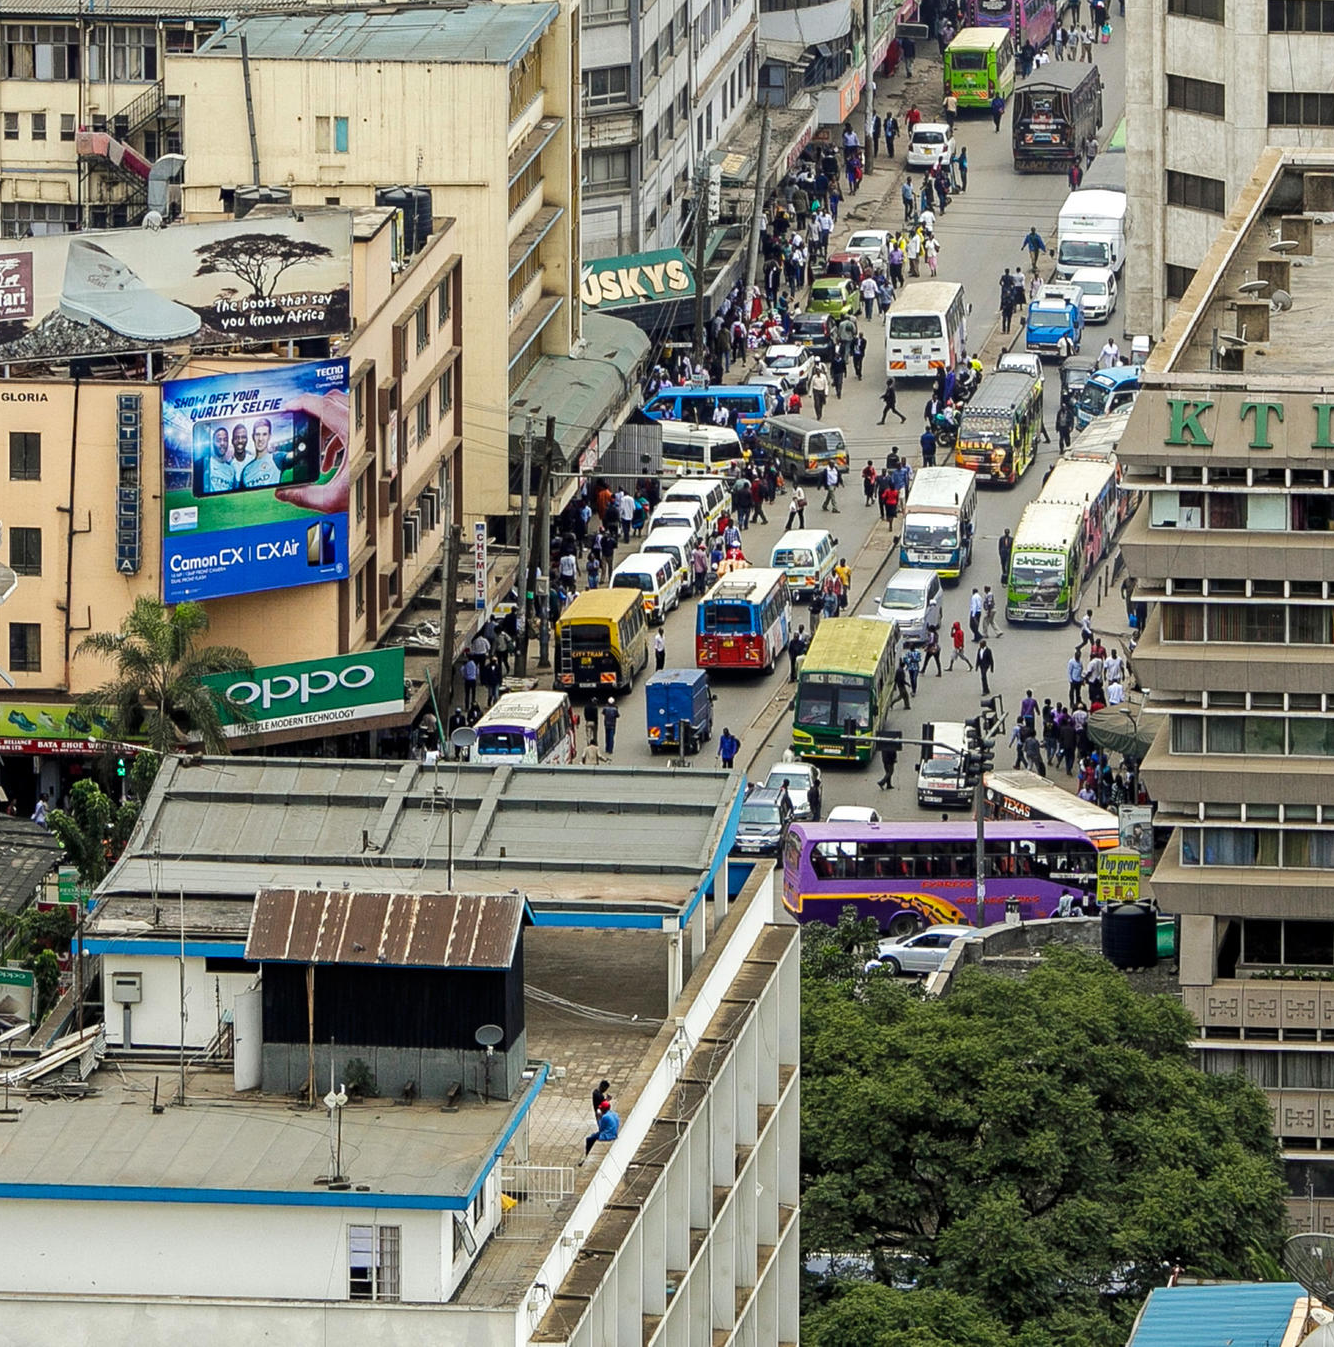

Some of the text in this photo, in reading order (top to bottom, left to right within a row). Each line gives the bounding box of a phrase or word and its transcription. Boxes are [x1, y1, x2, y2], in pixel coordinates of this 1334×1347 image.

[215, 293, 333, 313] The boots that say
[221, 308, 326, 330] you know Africa
[315, 365, 344, 378] TECNO
[0, 392, 49, 402] GLORIA
[173, 389, 260, 410] SHOW OFF YOUR
[190, 397, 283, 422] QUALITY SELFIE
[120, 396, 137, 468] HOTEL
[120, 489, 136, 571] GLORIA
[169, 538, 300, 573] Camon CX CX Air
[476, 533, 485, 598] CHEMIST
[225, 664, 375, 709] oppo
[270, 708, 357, 729] MODERN TECHNOLOGY
[37, 741, 58, 749] BATA
[1003, 796, 1032, 818] TEXAS
[1098, 855, 1140, 874] Top gear
[1120, 874, 1139, 882] SCHOOL
